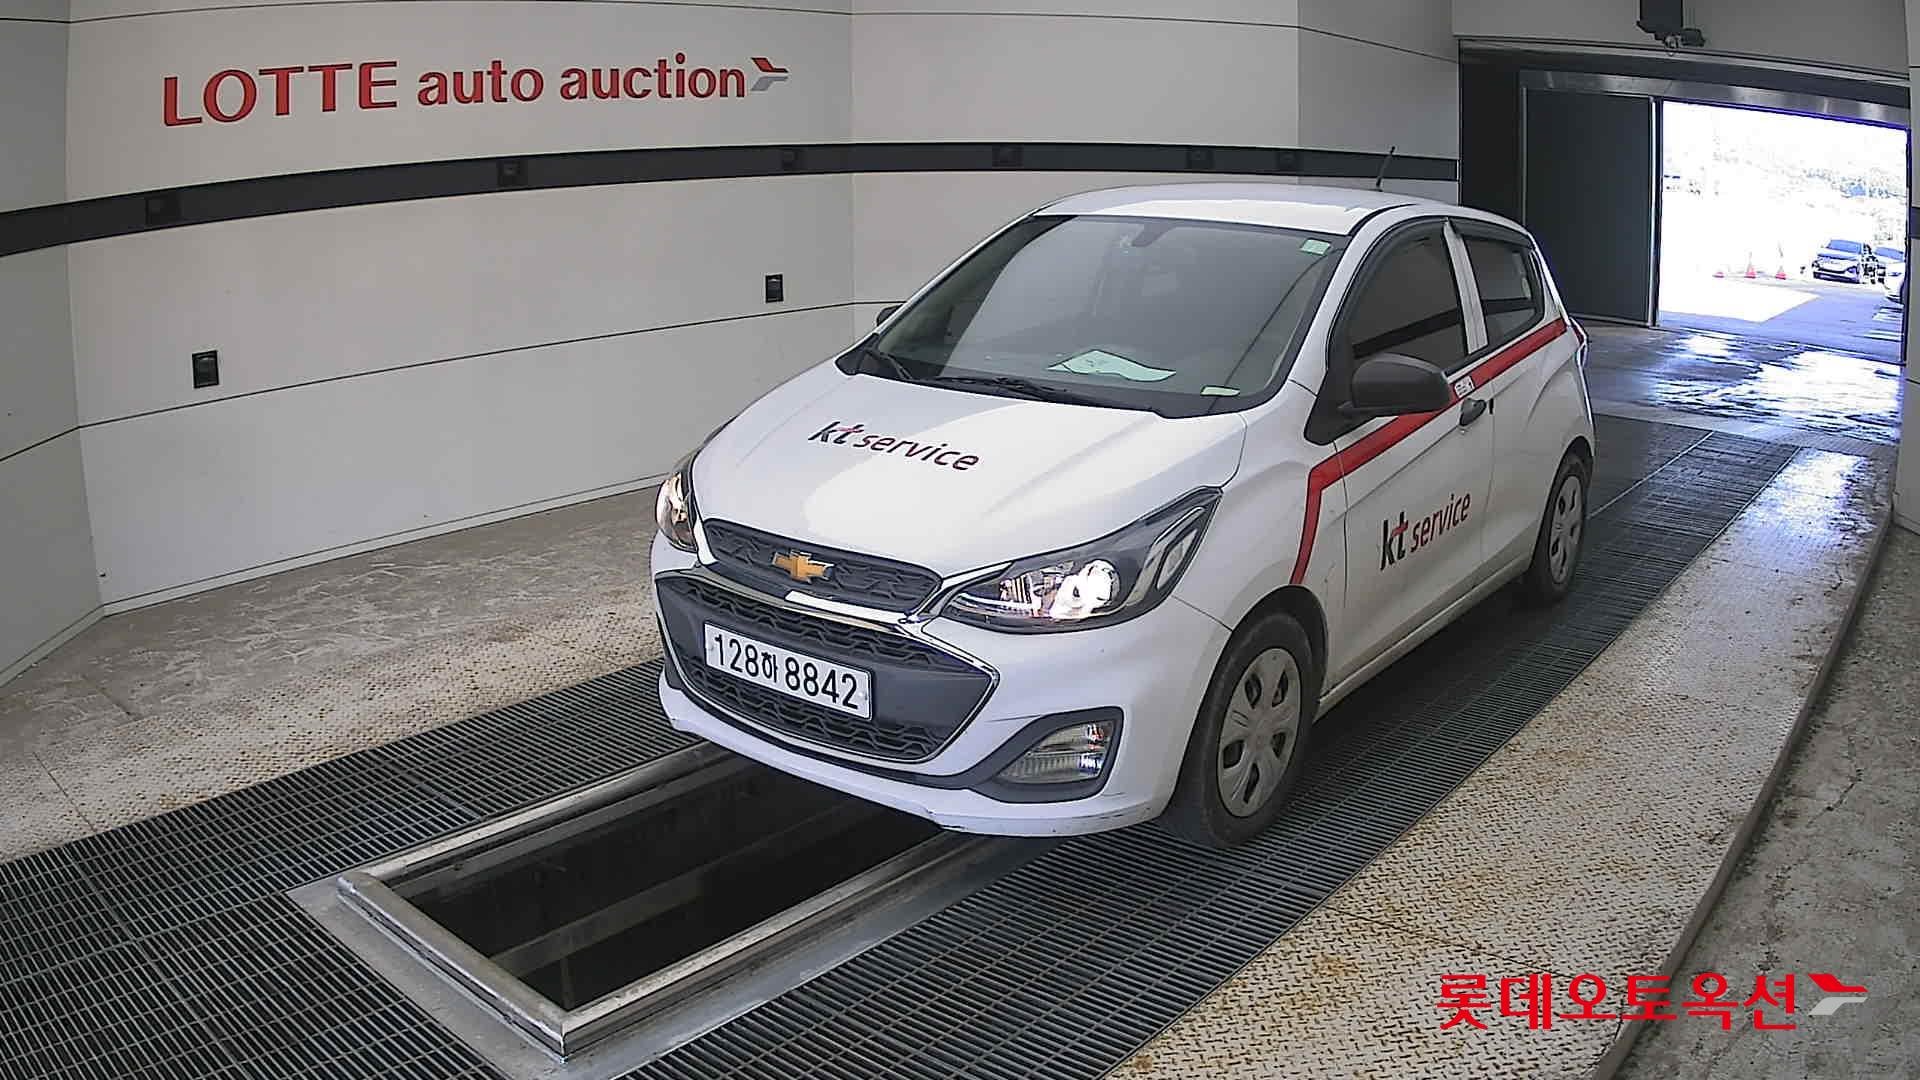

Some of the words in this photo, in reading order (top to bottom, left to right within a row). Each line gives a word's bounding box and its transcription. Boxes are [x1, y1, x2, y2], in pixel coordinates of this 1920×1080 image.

[163, 61, 398, 127] LOTTE
[417, 60, 544, 107] auto
[560, 53, 745, 101] auction
[807, 420, 865, 445] kt
[852, 434, 980, 471] service
[1380, 511, 1409, 572] kt
[1410, 493, 1471, 553] service
